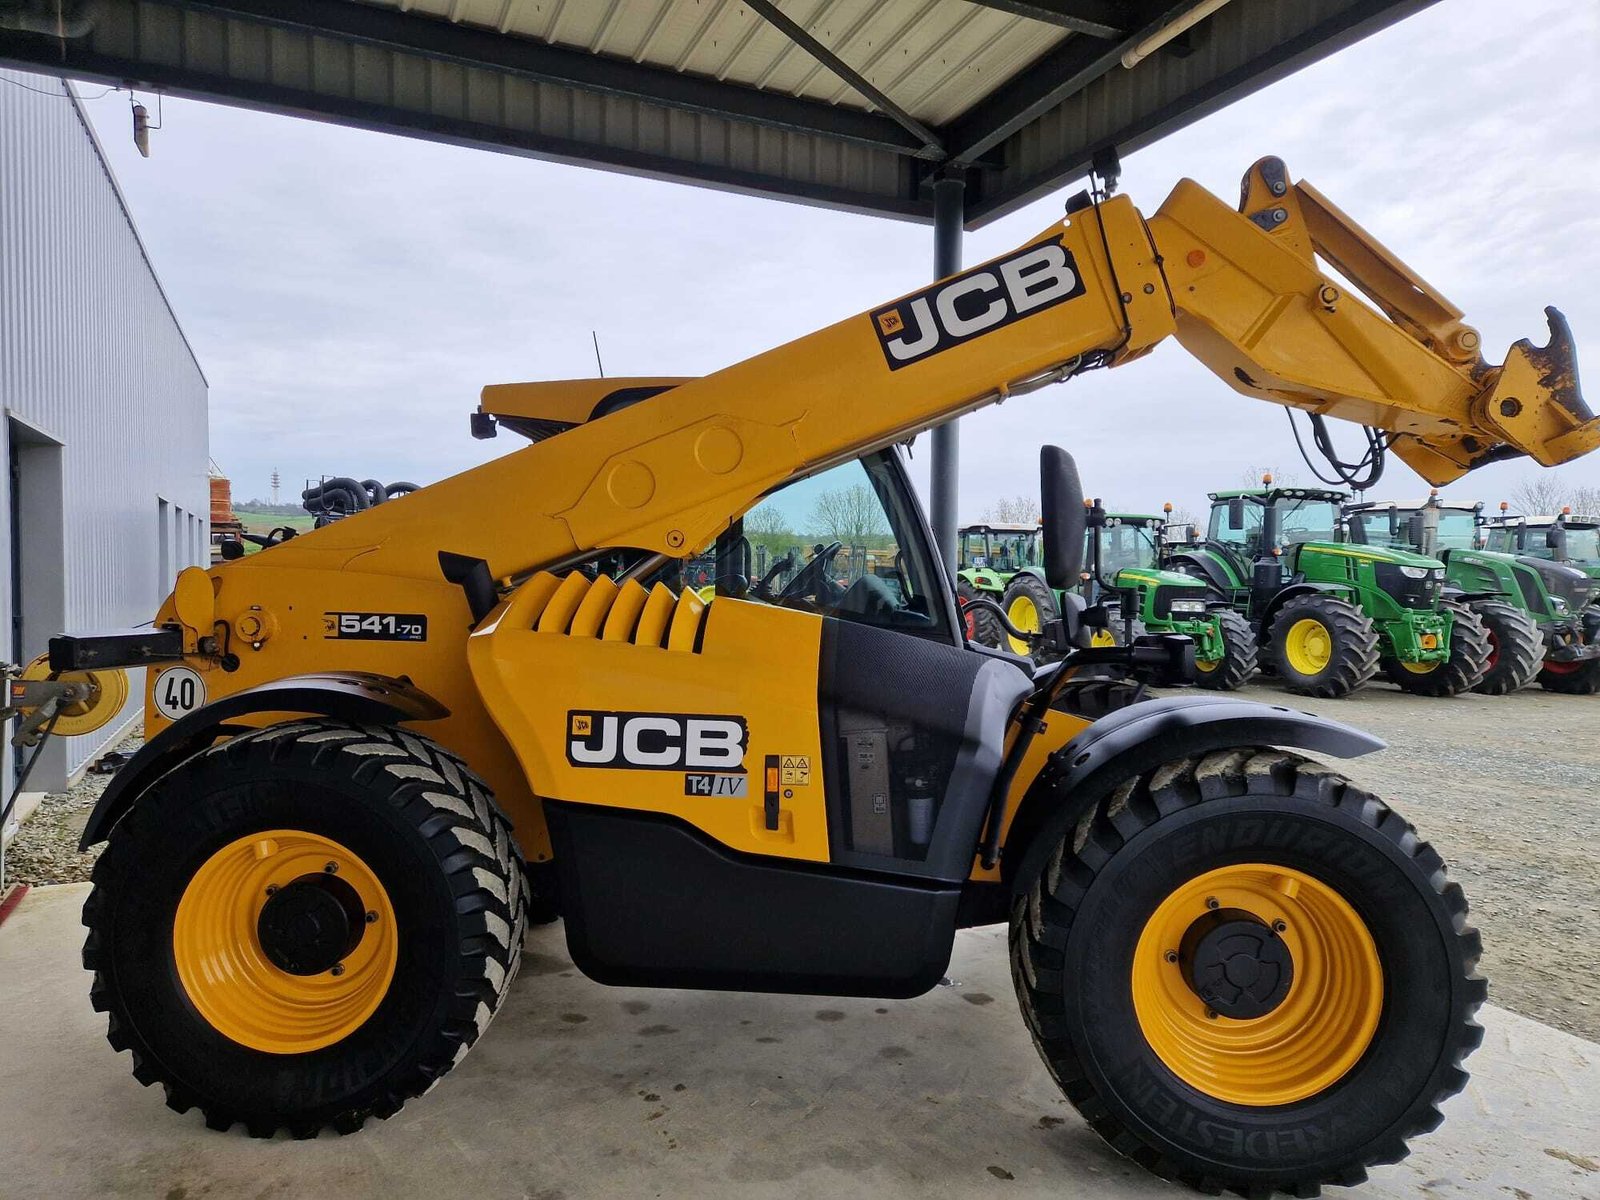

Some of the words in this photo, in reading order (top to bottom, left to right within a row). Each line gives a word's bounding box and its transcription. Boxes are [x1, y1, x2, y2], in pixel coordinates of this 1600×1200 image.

[887, 245, 1076, 360] JCB
[340, 614, 422, 634] 541-70
[165, 677, 194, 710] 40
[571, 716, 745, 768] JCB
[687, 775, 712, 795] T4
[716, 776, 744, 795] IV
